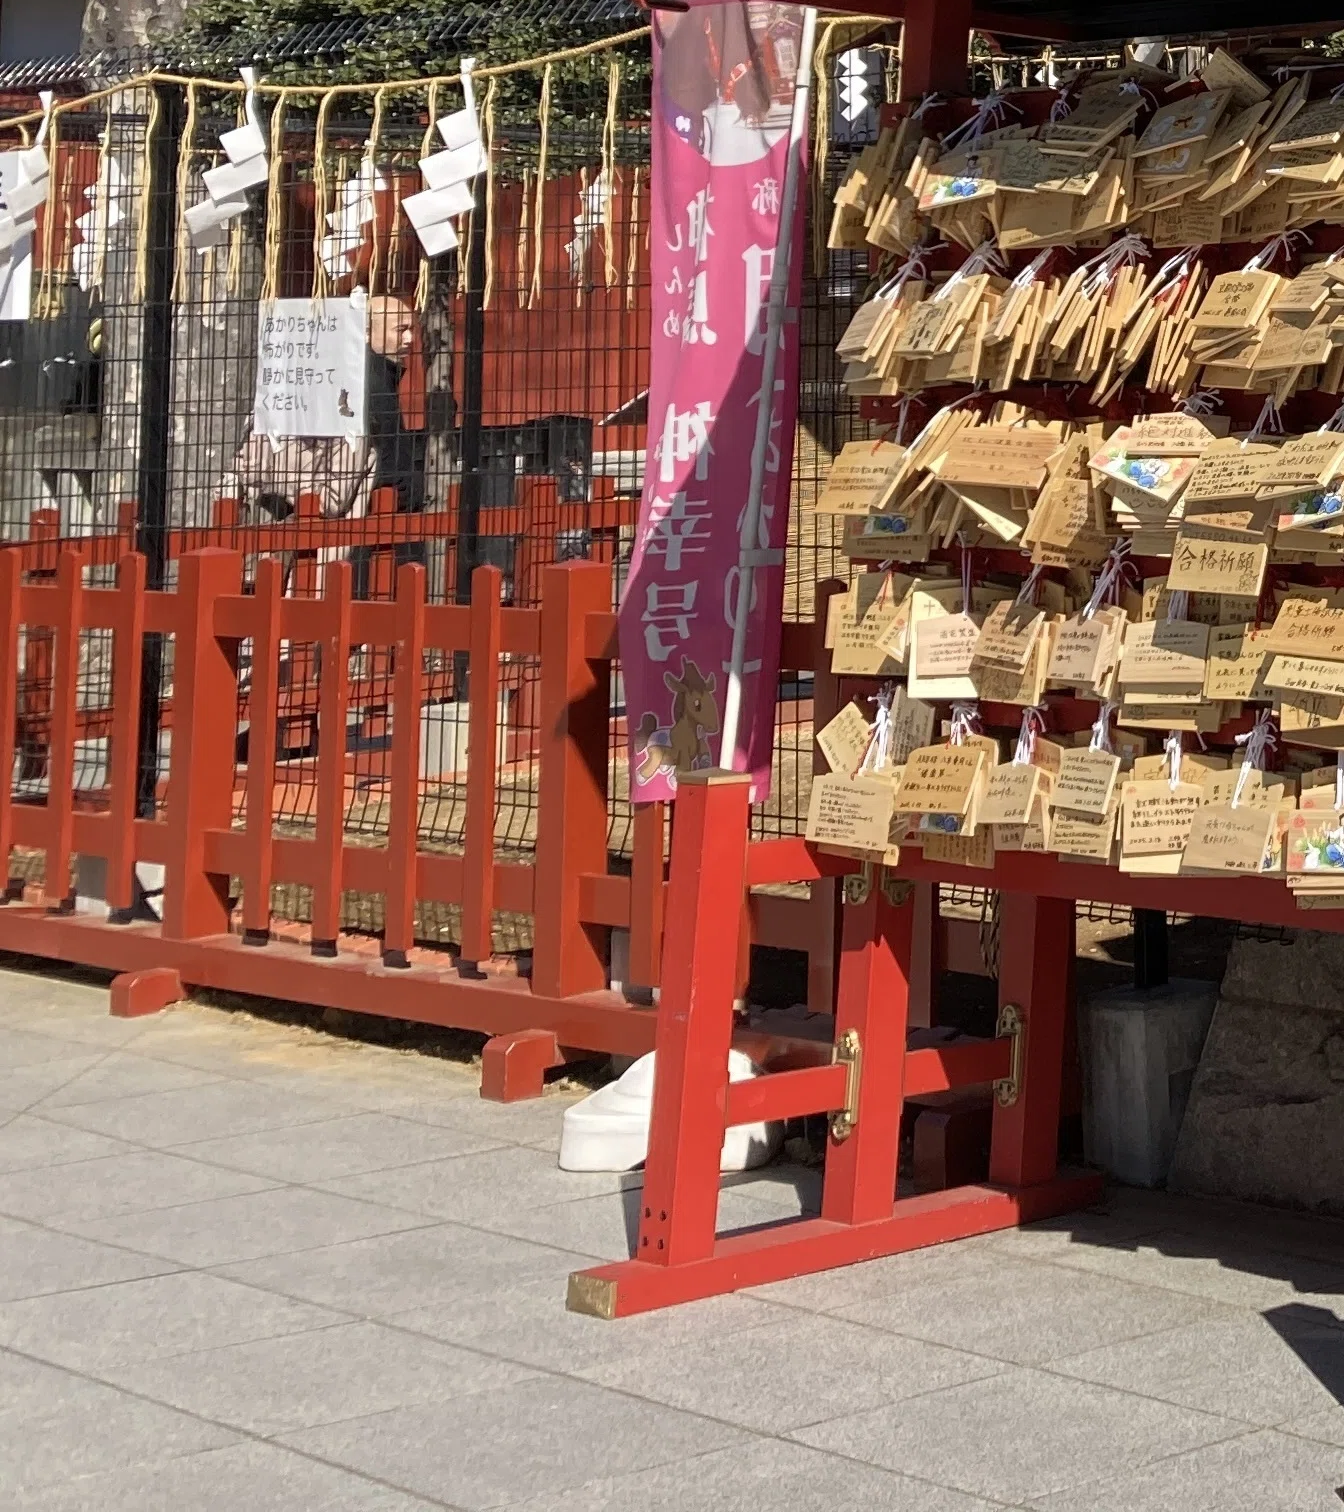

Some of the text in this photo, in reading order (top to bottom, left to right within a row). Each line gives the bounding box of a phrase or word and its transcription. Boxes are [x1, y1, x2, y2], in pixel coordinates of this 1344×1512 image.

[265, 316, 337, 333] あかりちゃんは
[262, 393, 308, 411] ください。
[1176, 544, 1256, 573] 合格祈願
